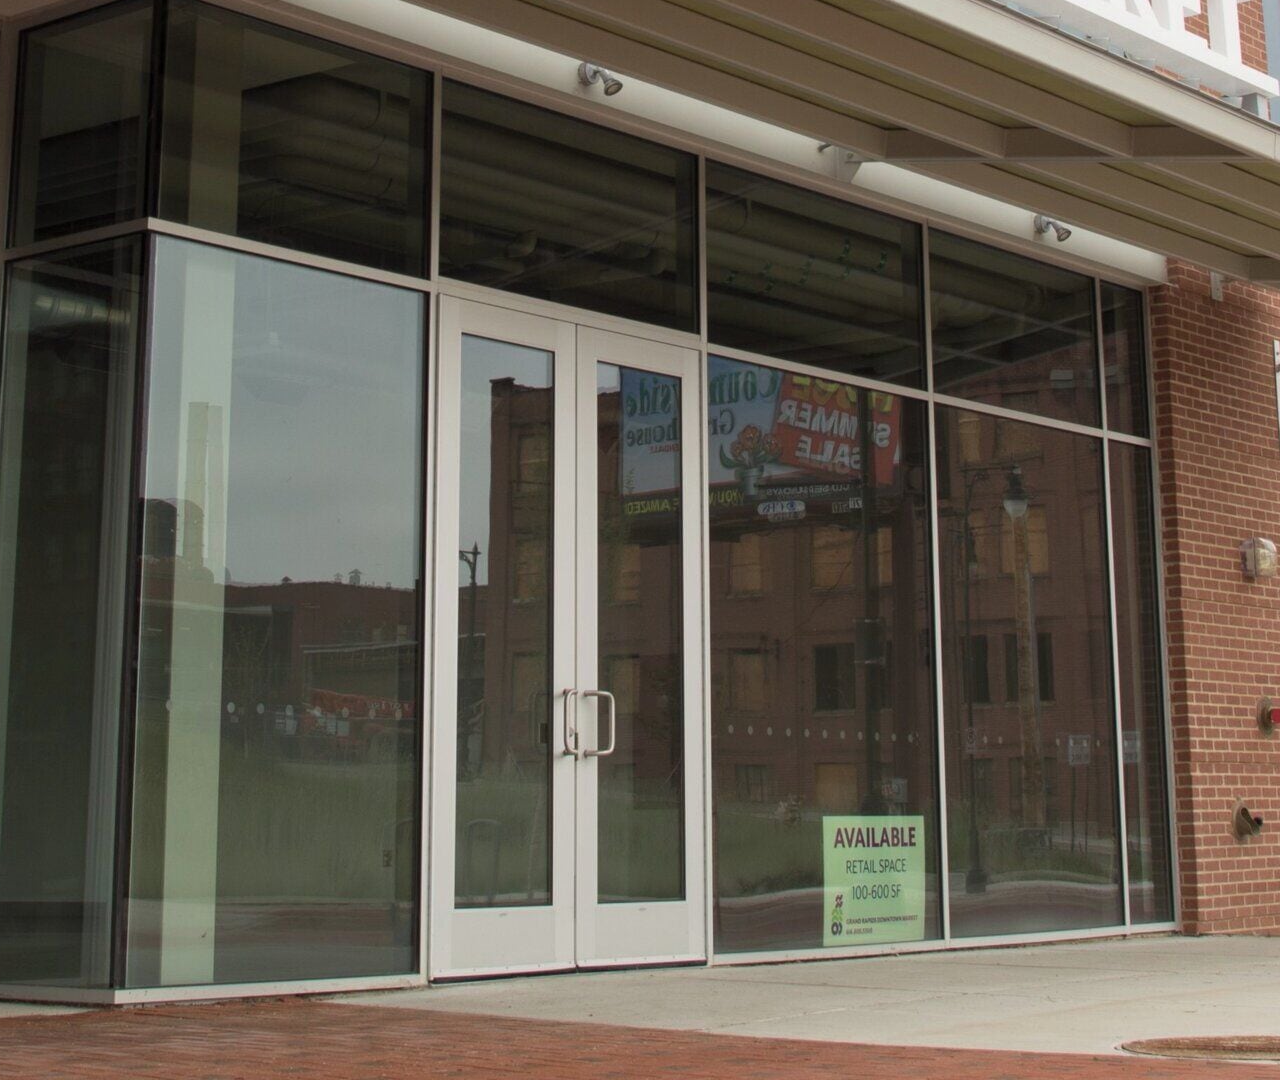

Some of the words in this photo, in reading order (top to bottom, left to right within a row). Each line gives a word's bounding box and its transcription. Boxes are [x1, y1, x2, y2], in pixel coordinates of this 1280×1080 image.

[833, 826, 917, 849] AVAILABLE
[845, 859, 877, 875] RETAIL
[879, 858, 907, 874] SPACE
[851, 884, 889, 901] 100-600
[891, 883, 902, 899] SF
